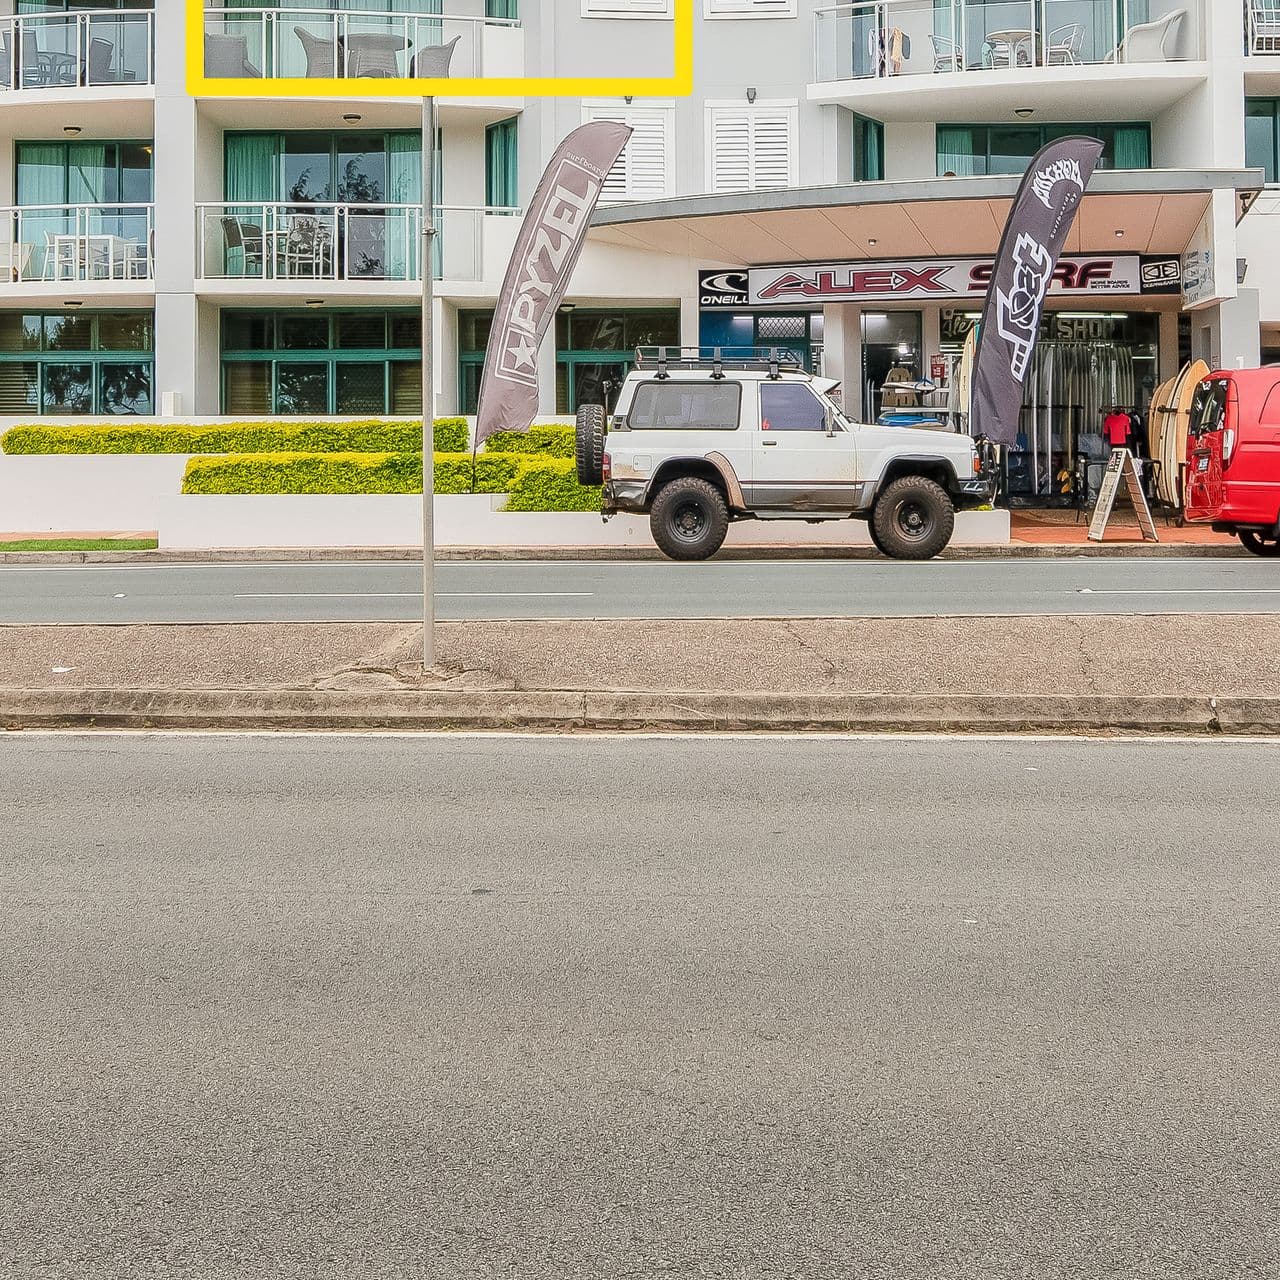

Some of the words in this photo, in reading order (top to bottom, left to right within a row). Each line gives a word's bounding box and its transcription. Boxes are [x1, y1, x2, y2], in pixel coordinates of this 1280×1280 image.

[509, 175, 600, 335] PYZEL
[757, 266, 957, 299] ALEX
[967, 260, 1114, 291] SRF
